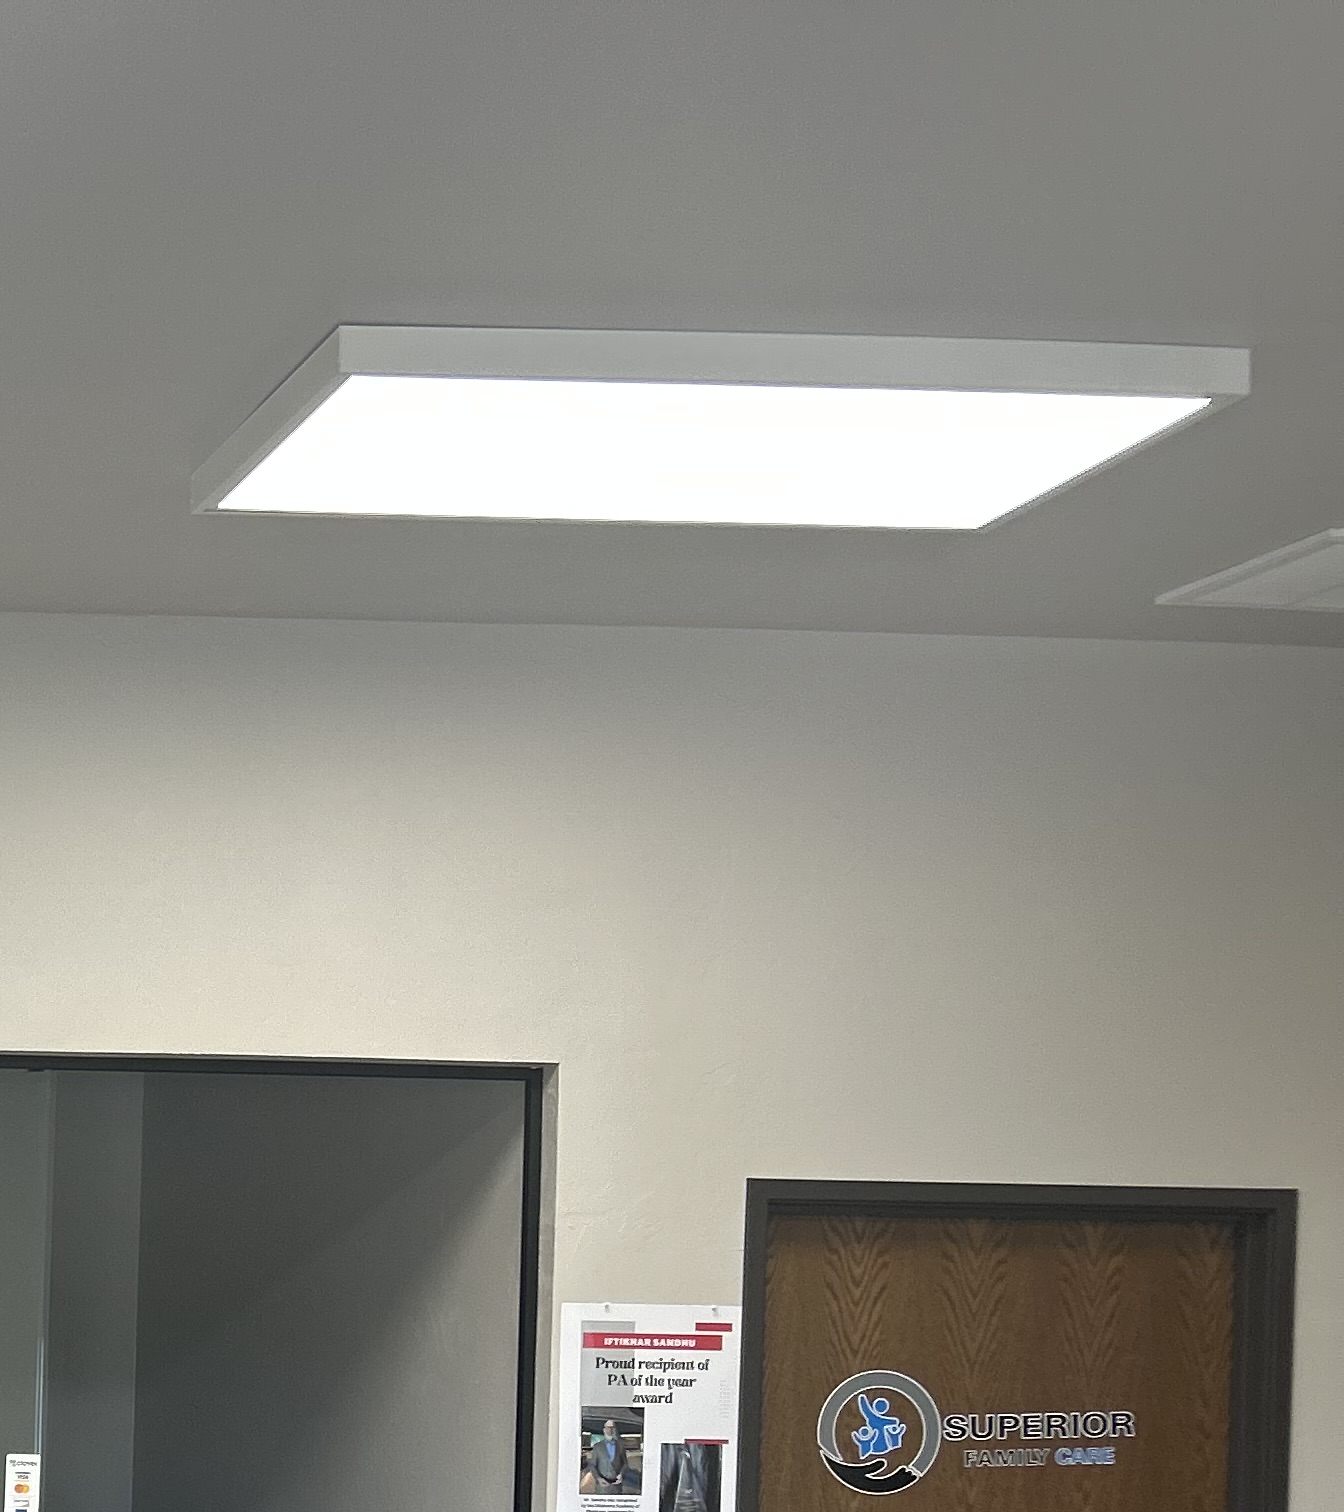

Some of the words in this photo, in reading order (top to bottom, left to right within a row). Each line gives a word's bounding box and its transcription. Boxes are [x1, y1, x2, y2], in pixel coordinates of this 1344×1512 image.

[595, 1357, 635, 1370] Proud
[638, 1358, 694, 1373] recipient
[698, 1359, 709, 1371] of
[607, 1374, 628, 1386] PA
[630, 1375, 643, 1387] of
[645, 1375, 665, 1387] the
[668, 1377, 697, 1390] year
[633, 1393, 673, 1404] award
[943, 1411, 1136, 1441] SUPERIOR
[963, 1448, 1051, 1467] FAMILY
[1054, 1446, 1116, 1466] CARE
